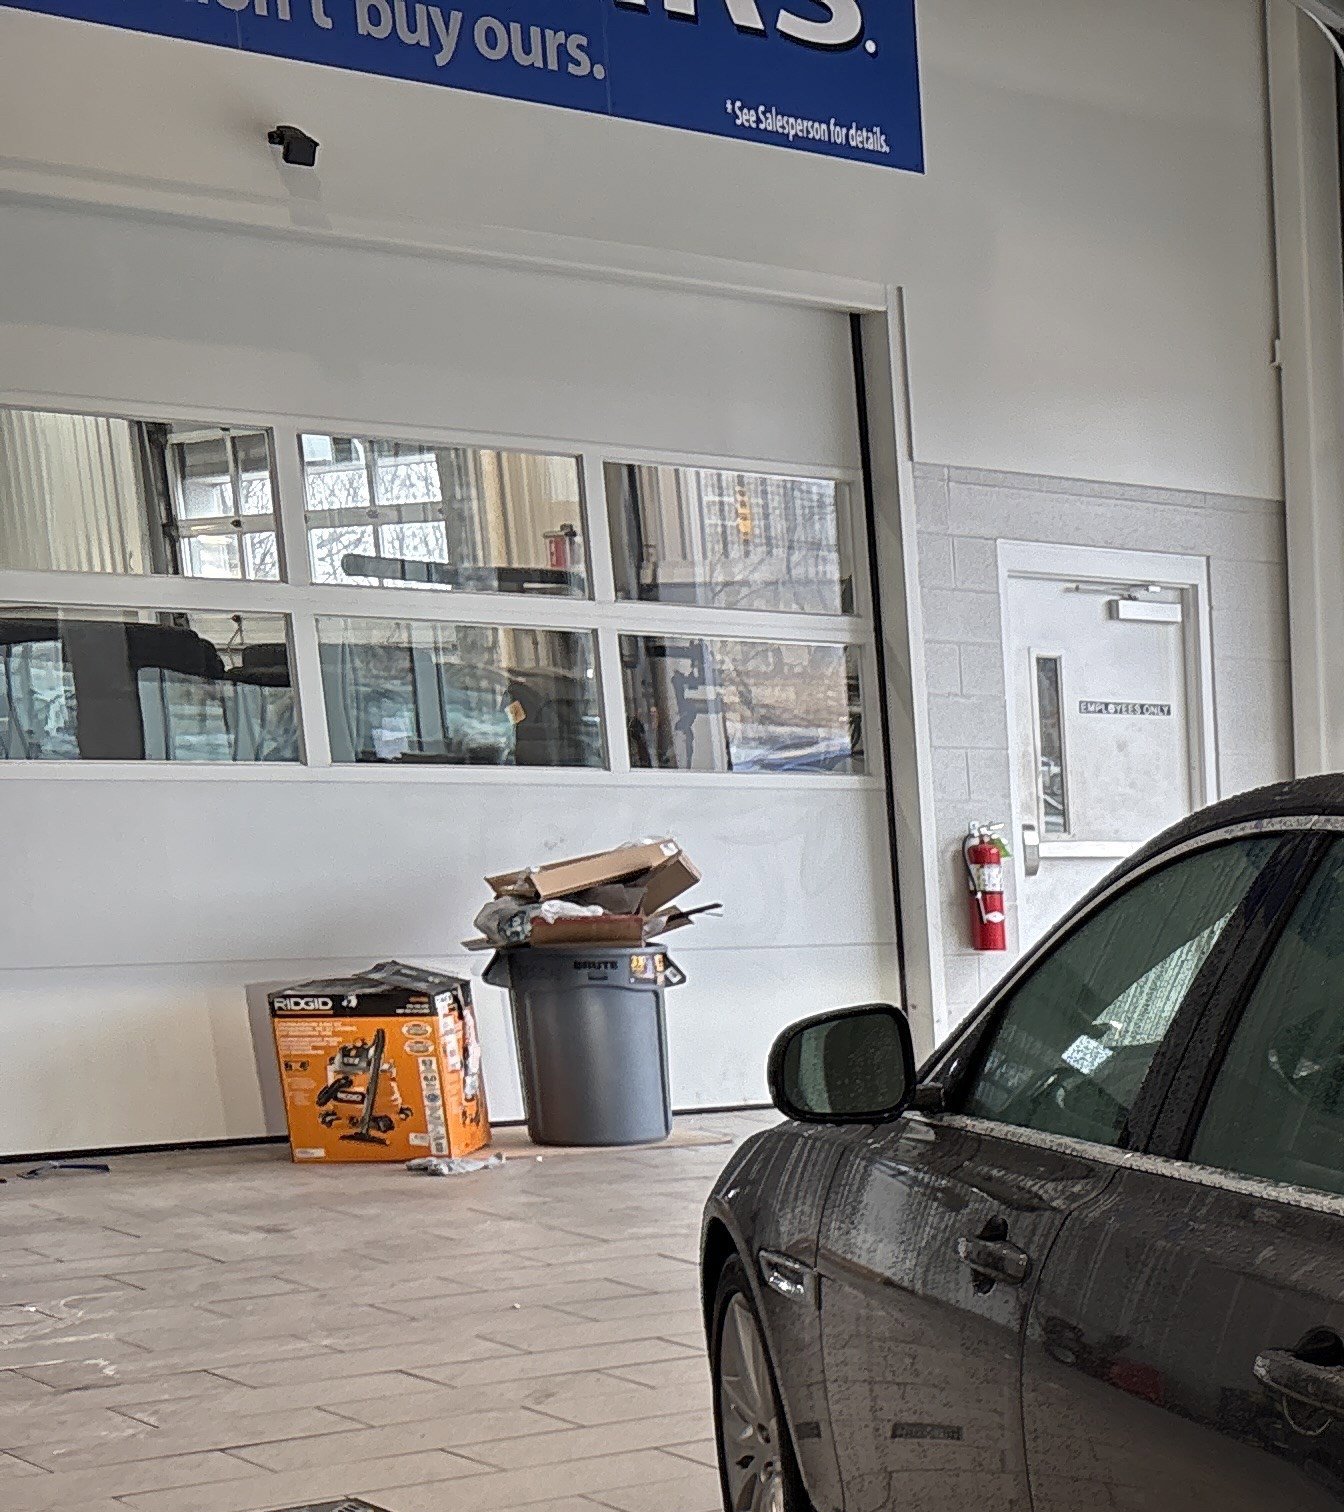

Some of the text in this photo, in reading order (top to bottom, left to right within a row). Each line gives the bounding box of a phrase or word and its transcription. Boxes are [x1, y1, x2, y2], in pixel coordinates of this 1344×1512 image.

[355, 0, 463, 67] buy
[473, 16, 606, 81] ours.
[758, 105, 829, 142] Salesperson
[829, 118, 848, 145] for
[848, 122, 890, 154] details.
[1080, 702, 1169, 716] EMPLOYEES ONLY
[274, 997, 333, 1011] RIDGID
